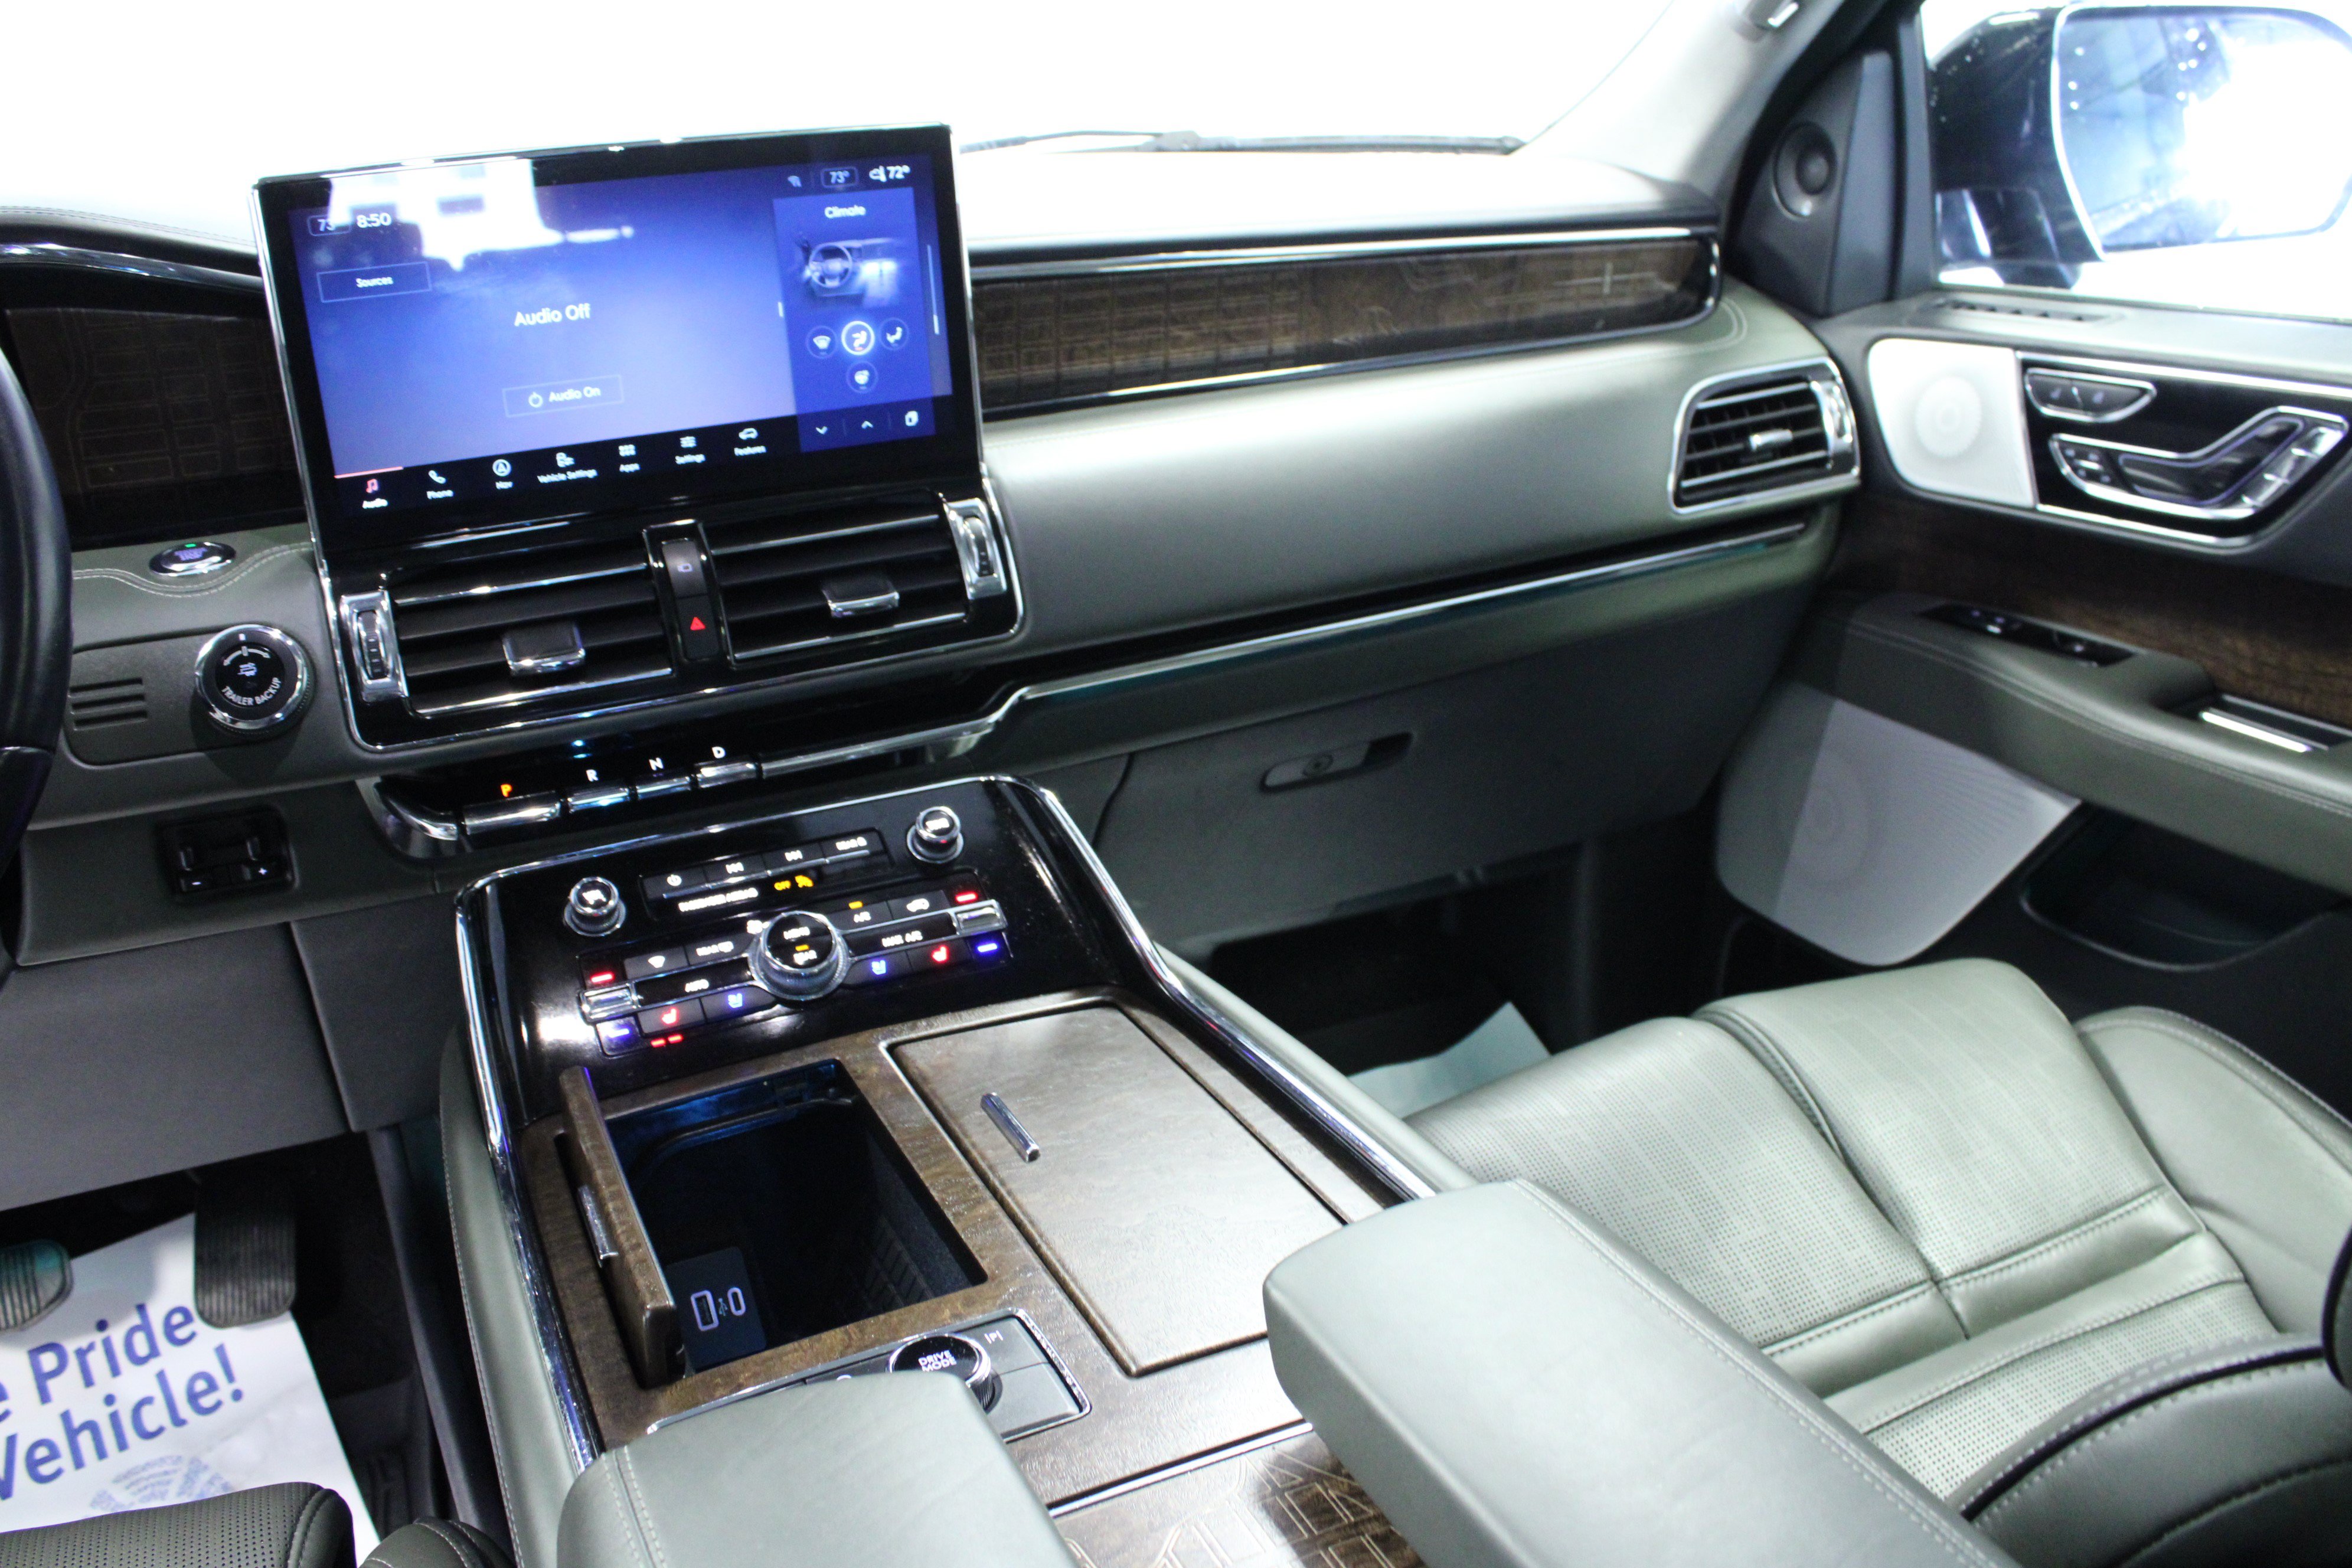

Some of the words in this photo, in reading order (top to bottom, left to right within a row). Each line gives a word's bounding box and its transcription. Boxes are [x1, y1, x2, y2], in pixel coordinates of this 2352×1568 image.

[824, 205, 866, 219] Climate
[355, 276, 394, 288] Sources
[514, 308, 563, 326] Audio
[565, 303, 590, 321] Off
[548, 388, 583, 402] Audio
[583, 386, 601, 397] On
[675, 453, 705, 465] Settings
[619, 463, 640, 473] Apps
[537, 473, 567, 483] Vehicle
[566, 469, 597, 479] Settings
[495, 481, 513, 489] Nav
[426, 489, 453, 499] Phone
[362, 498, 388, 509] Audio
[221, 685, 254, 705] TRAILER
[254, 677, 282, 705] BACKUP
[711, 746, 725, 758] D
[649, 757, 664, 771] N
[586, 769, 599, 782] R
[500, 783, 512, 797] P
[27, 1303, 198, 1405] Pride
[918, 1350, 953, 1366] DRIVE
[922, 1356, 956, 1372] MODE
